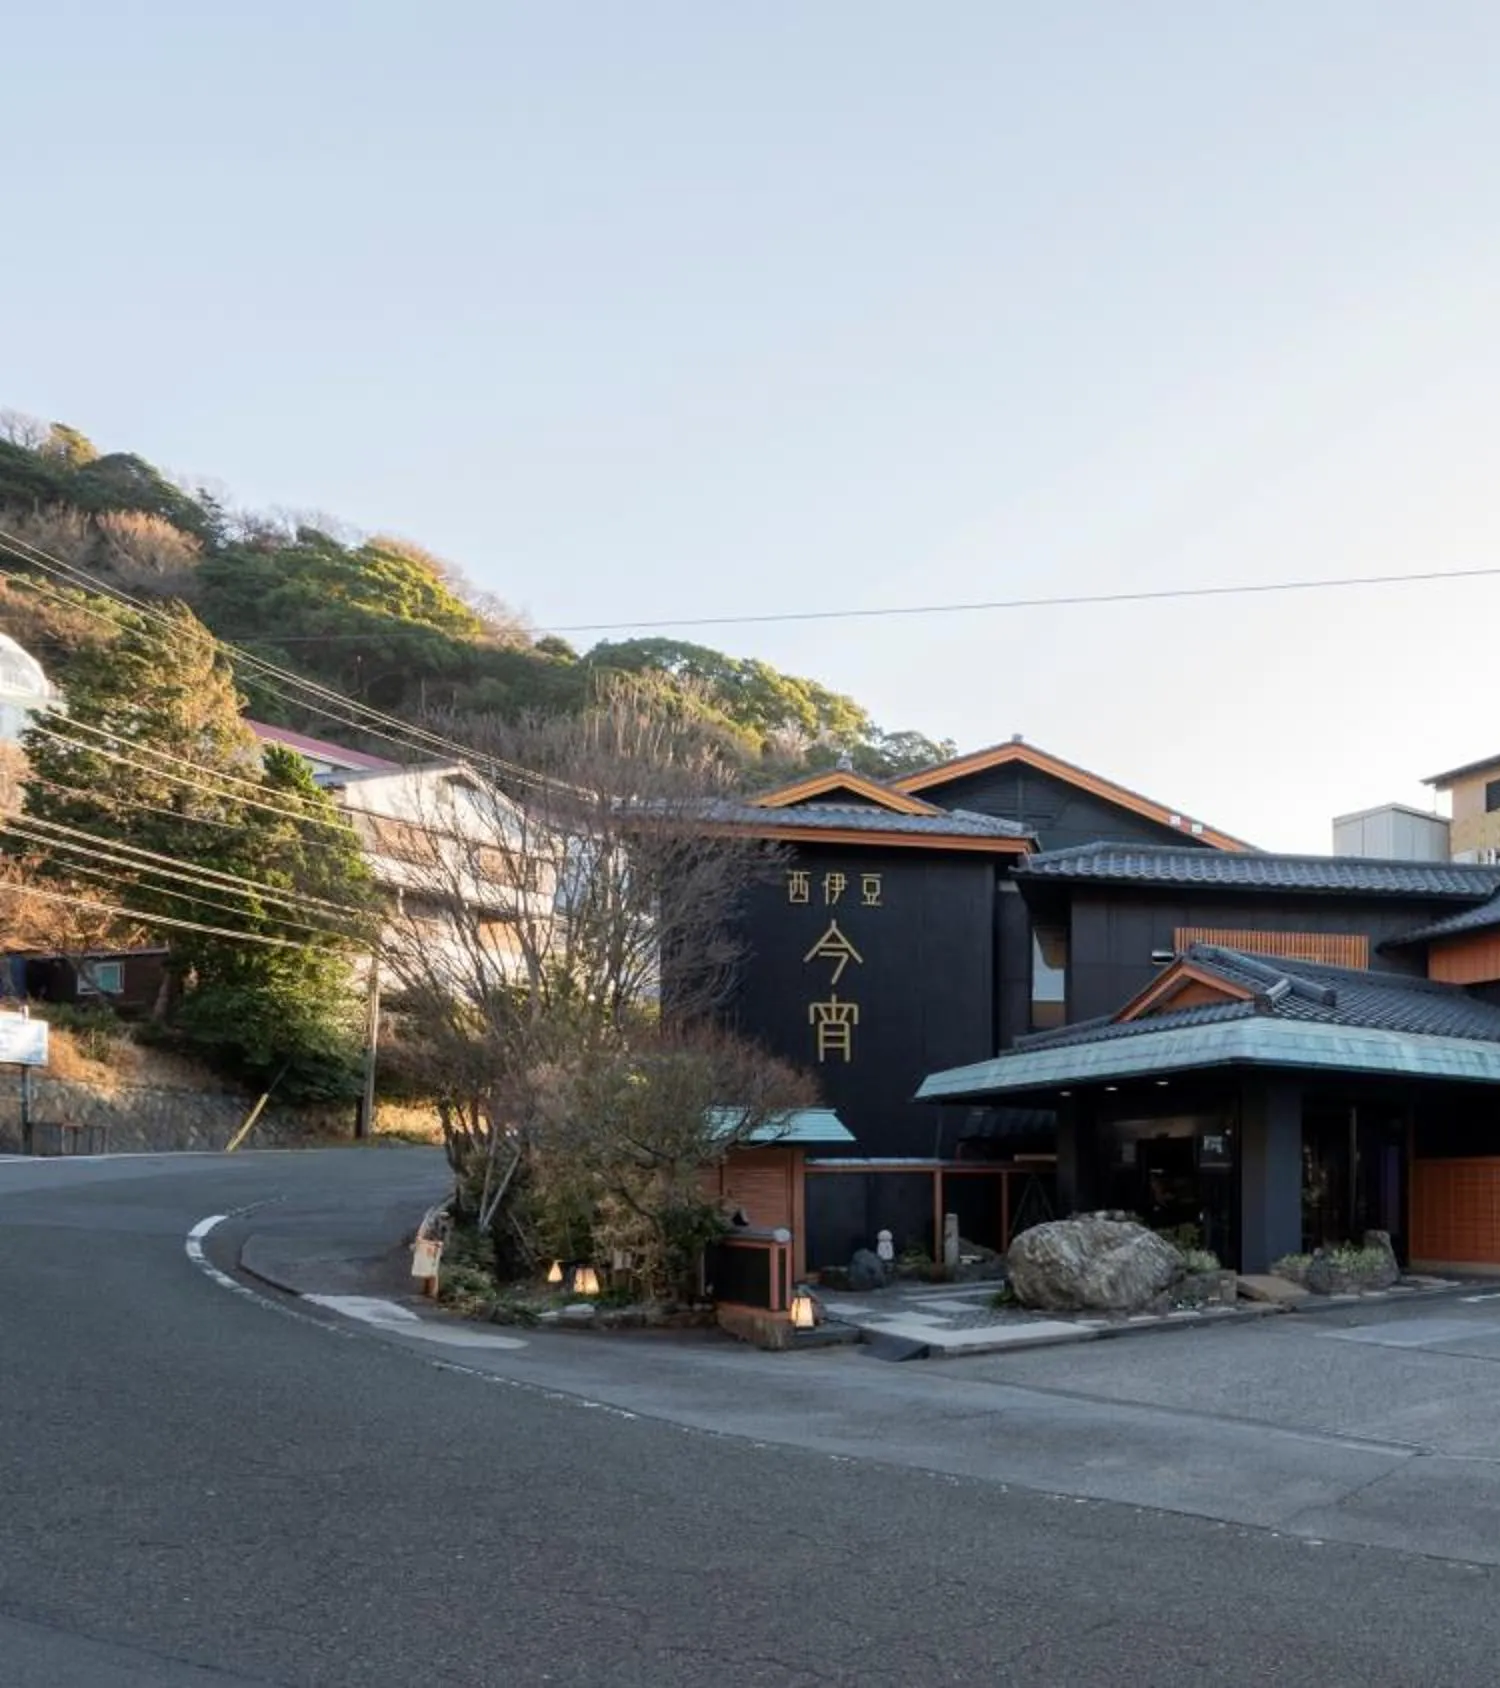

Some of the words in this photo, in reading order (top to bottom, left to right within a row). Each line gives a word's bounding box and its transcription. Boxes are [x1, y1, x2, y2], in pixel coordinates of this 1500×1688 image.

[787, 870, 883, 906] 西伊豆
[802, 918, 864, 1063] 今宵
